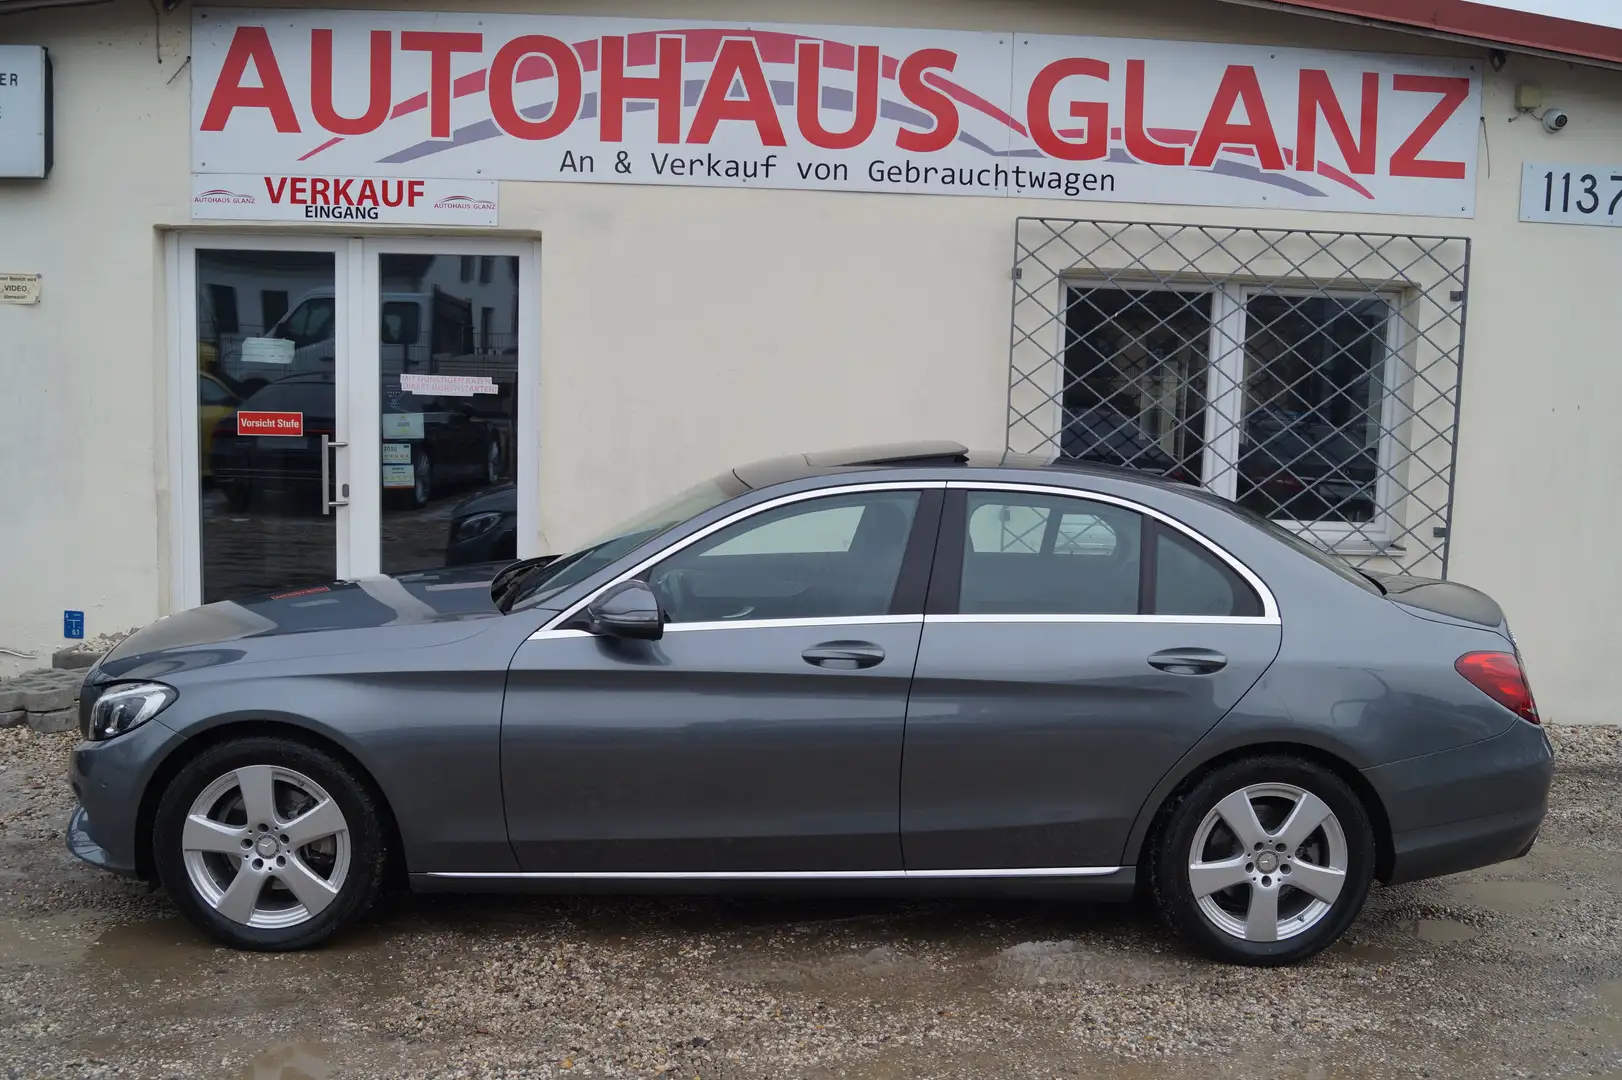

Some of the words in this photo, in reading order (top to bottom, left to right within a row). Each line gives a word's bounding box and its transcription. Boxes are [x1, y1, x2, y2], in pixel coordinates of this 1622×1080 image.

[200, 26, 960, 152] AUTOHAUS
[1026, 57, 1470, 180] GLANZ
[559, 150, 594, 173] An
[614, 150, 632, 174] &
[650, 152, 777, 178] Verkauf
[797, 162, 849, 181] von
[868, 160, 1116, 196] Gebrauchtwagen
[264, 176, 425, 208] VERKAUF
[305, 205, 379, 220] EINGANG
[4, 284, 28, 292] VIDEO
[241, 418, 276, 428] Vorsicht
[277, 419, 300, 428] Stufe
